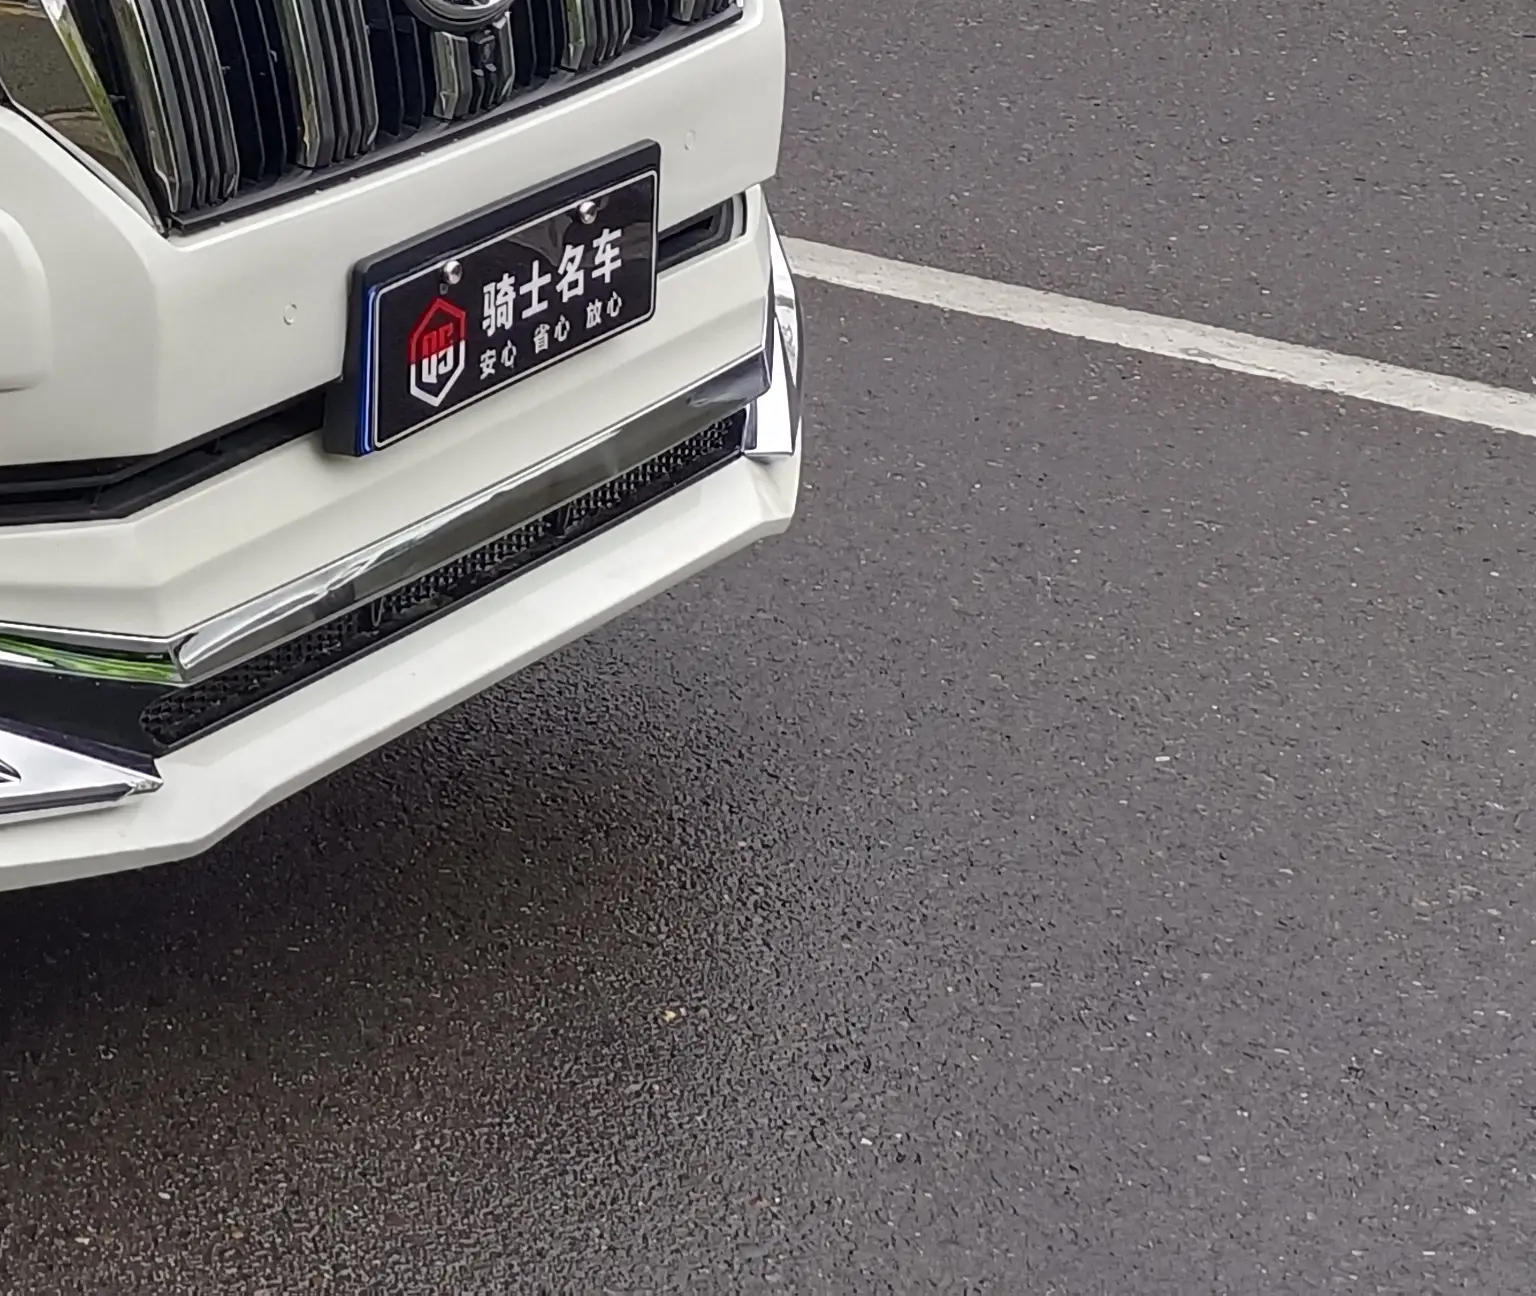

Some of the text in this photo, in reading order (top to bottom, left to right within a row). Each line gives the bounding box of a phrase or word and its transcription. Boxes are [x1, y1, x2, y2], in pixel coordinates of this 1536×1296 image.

[482, 228, 622, 337] 骑士名车
[480, 291, 622, 380] 安心 省心 放心
